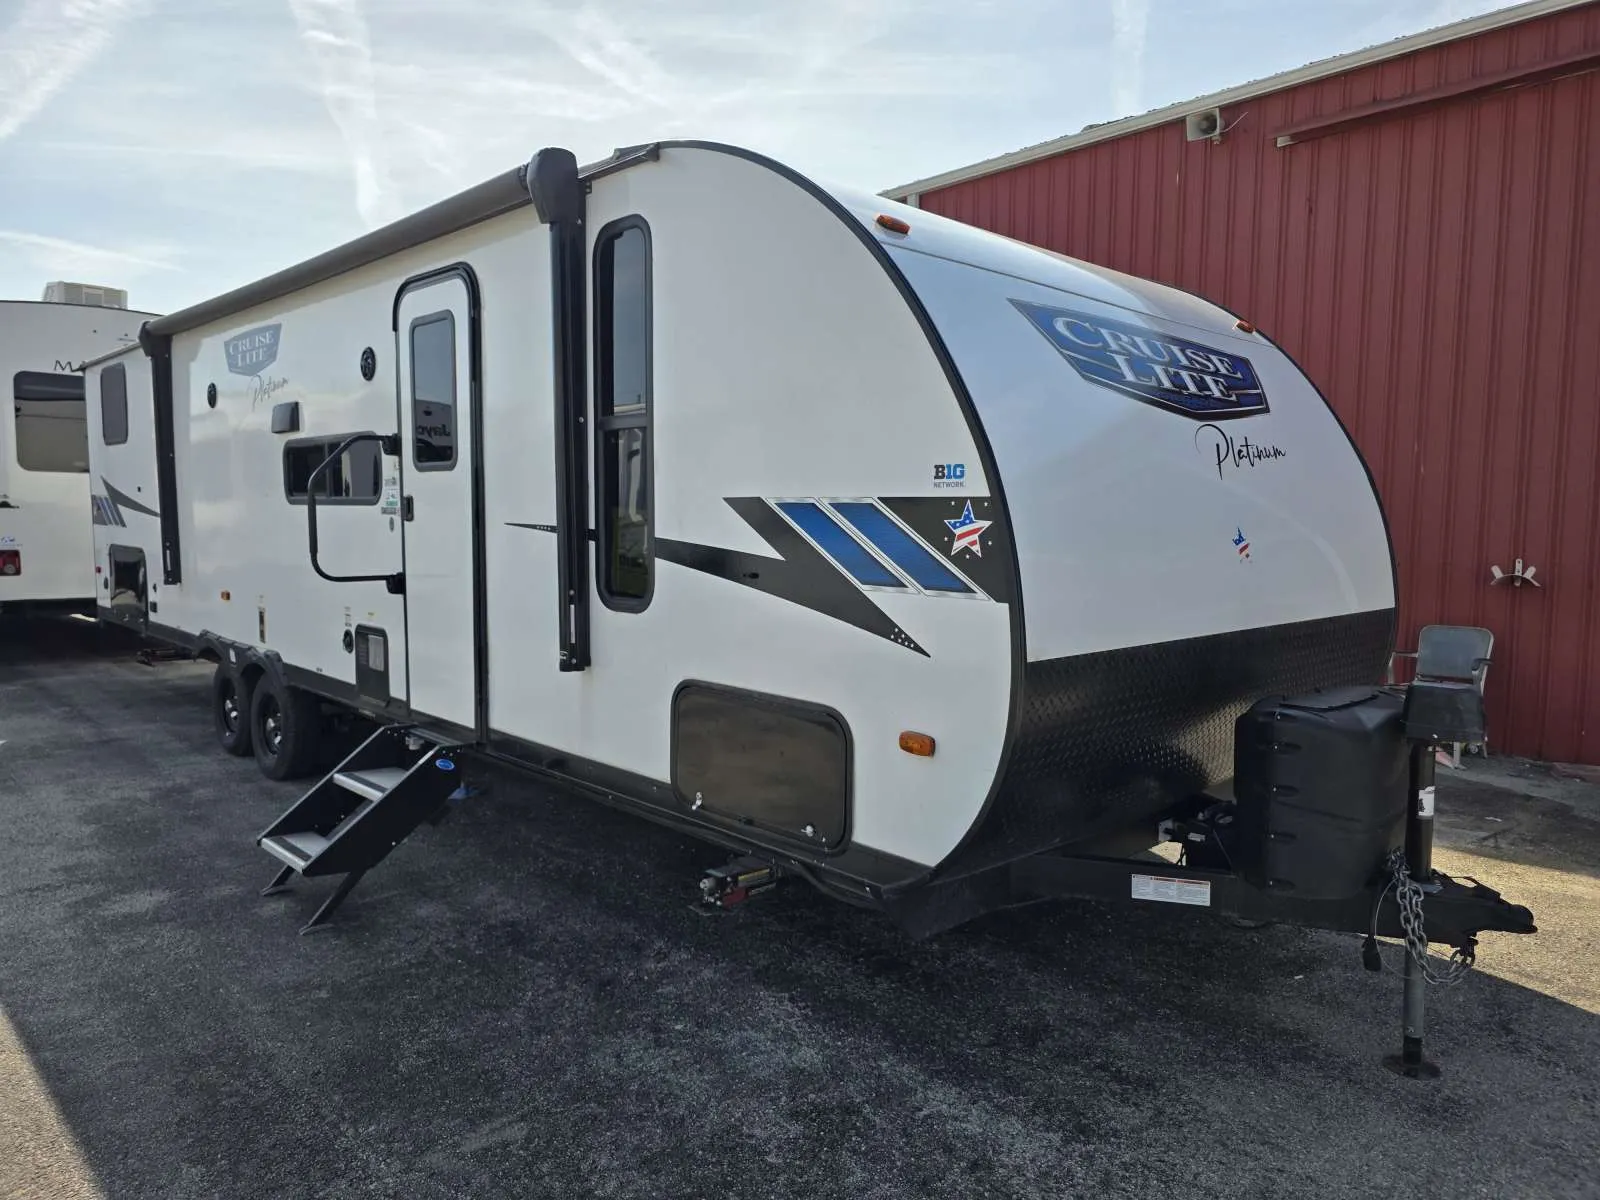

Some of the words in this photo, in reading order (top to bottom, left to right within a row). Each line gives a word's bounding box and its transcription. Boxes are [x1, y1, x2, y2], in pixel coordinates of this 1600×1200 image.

[229, 331, 275, 355] CRUISE
[1053, 317, 1243, 379] CRUISE
[1106, 352, 1237, 402] LITE
[1195, 423, 1286, 481] Platinum
